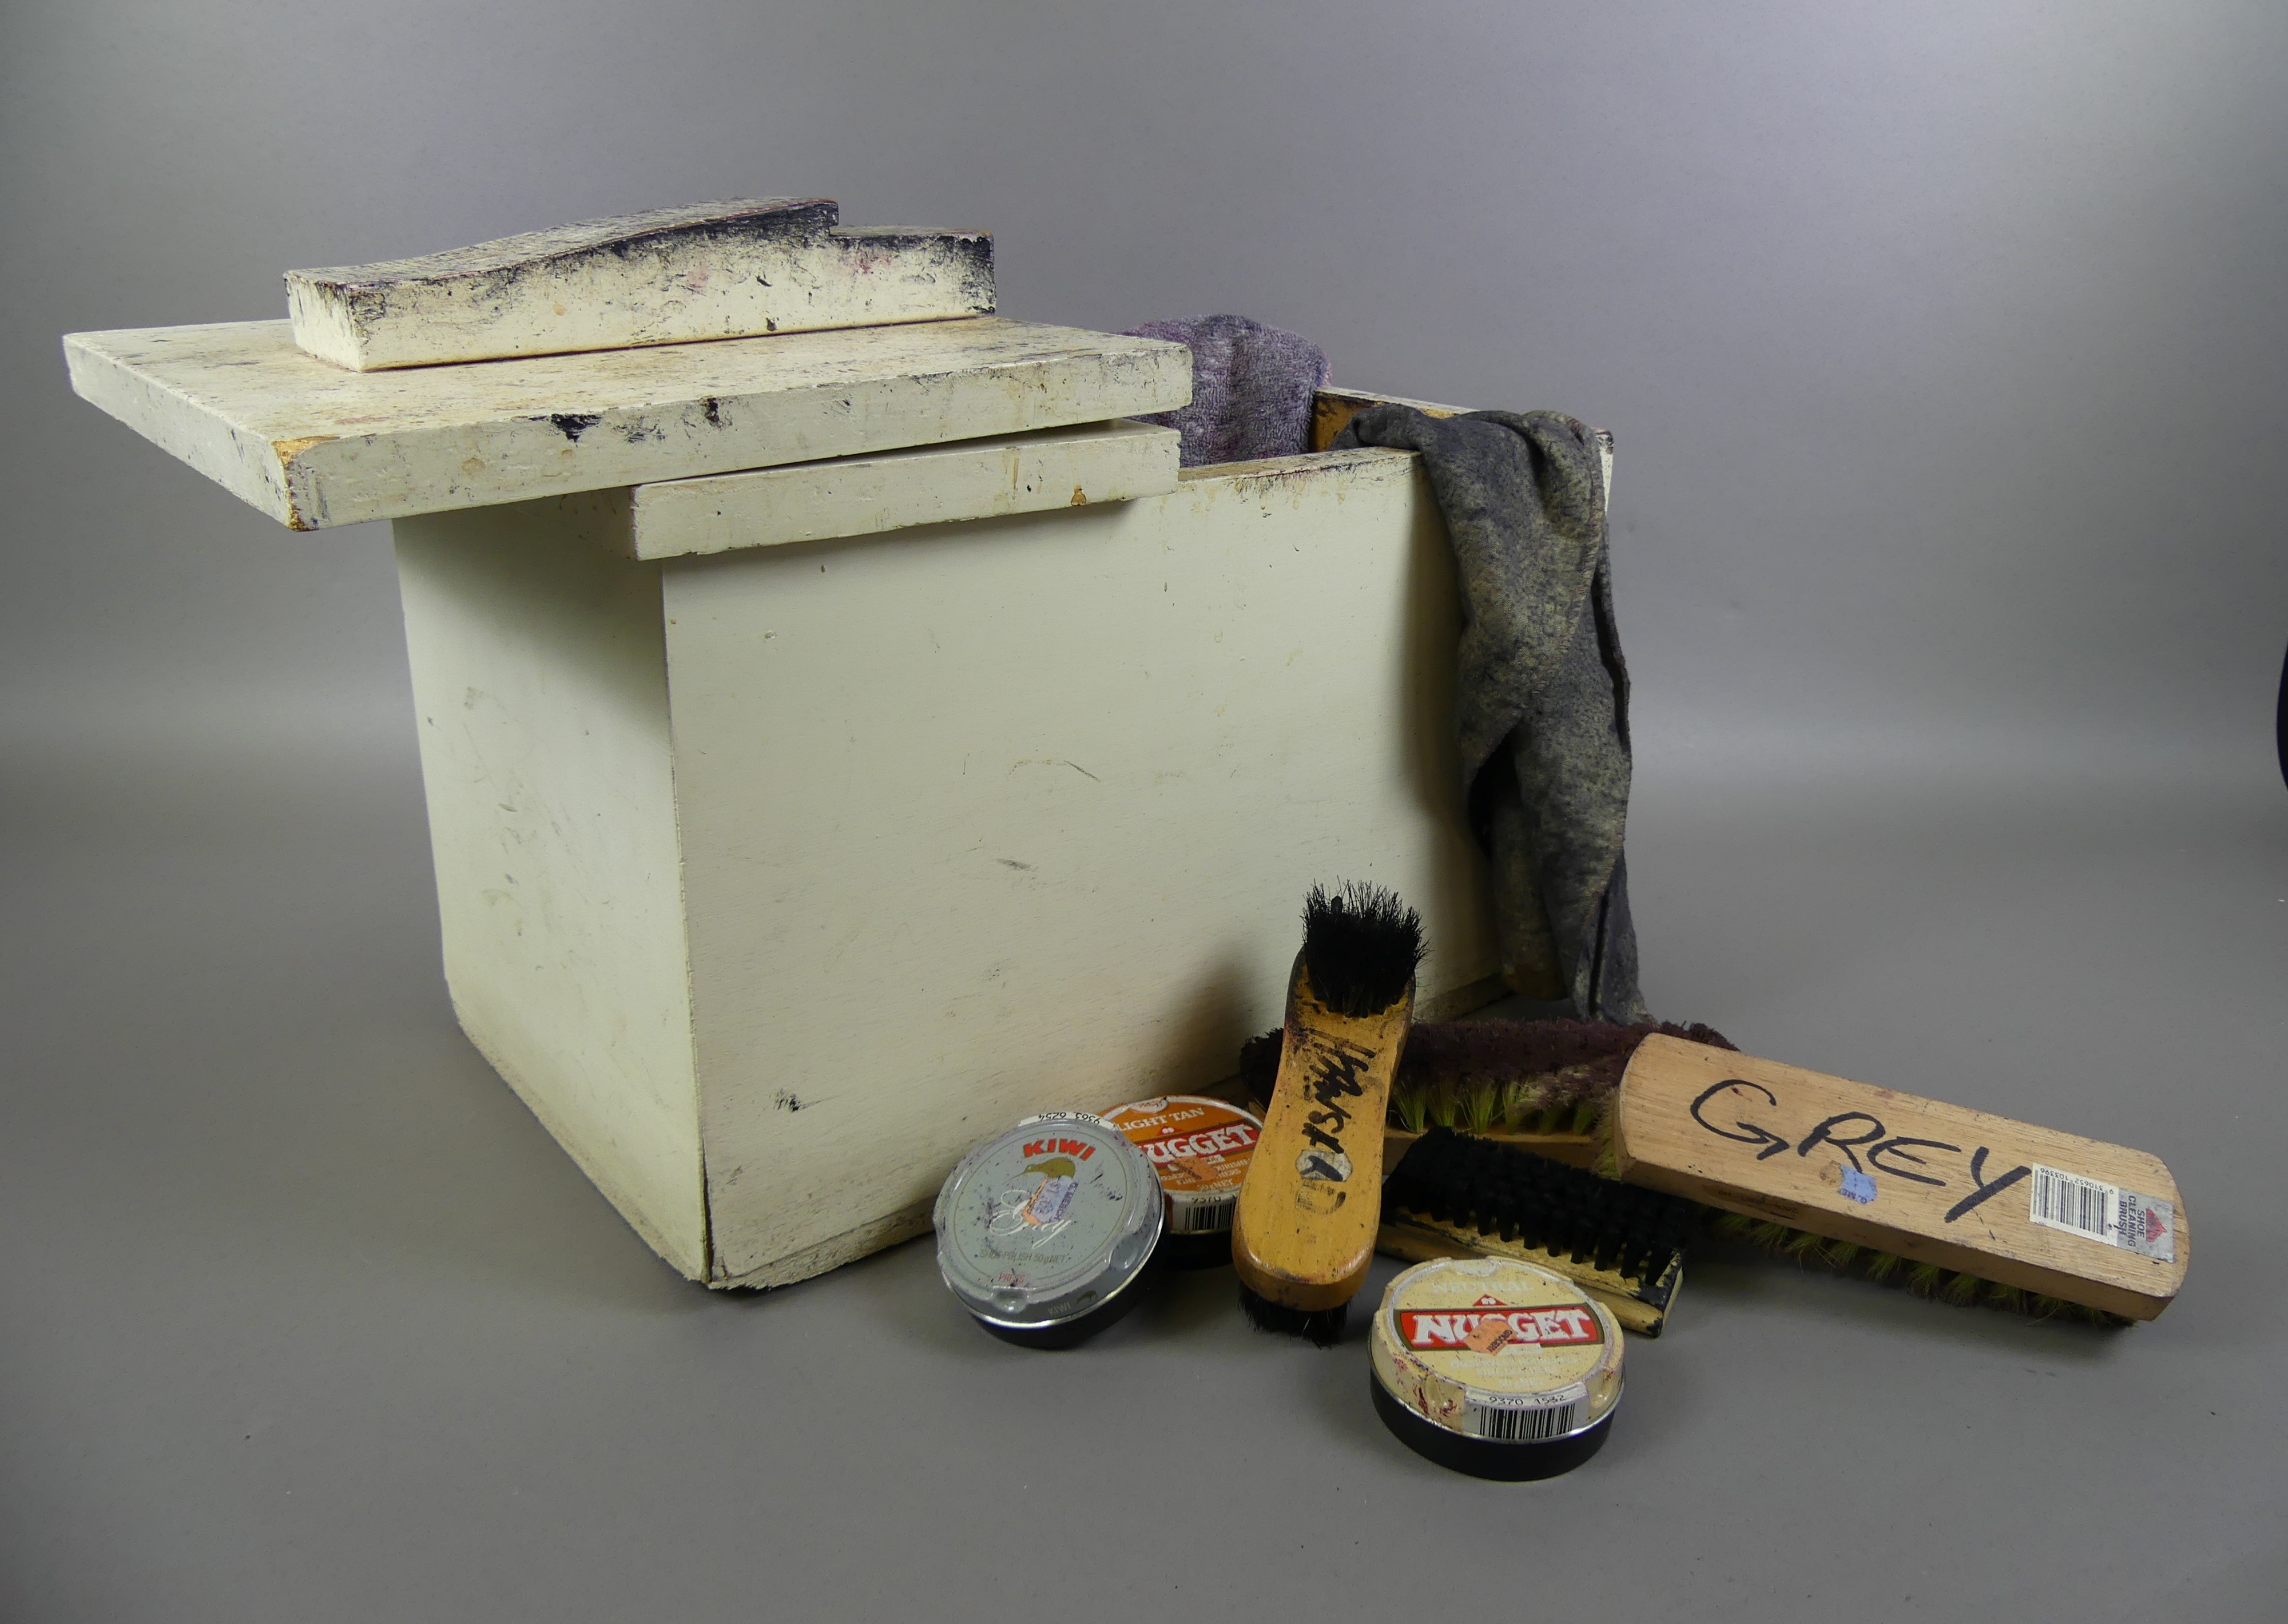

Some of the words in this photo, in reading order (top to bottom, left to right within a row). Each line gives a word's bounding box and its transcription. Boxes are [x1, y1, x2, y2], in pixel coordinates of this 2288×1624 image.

[1117, 1115, 1167, 1131] LIGHT
[1169, 1107, 1205, 1121] TAN
[1023, 1138, 1097, 1161] KIWI
[1138, 1123, 1255, 1163] UGGET
[1691, 1079, 2031, 1223] GREY
[2040, 1167, 2068, 1181] 103396
[2119, 1201, 2128, 1236] BRUSH
[2128, 1195, 2136, 1247] CLEANING
[2136, 1209, 2145, 1238] SHOE
[1432, 1280, 1534, 1293] NEUTRAL
[1412, 1309, 1591, 1345] NUGET
